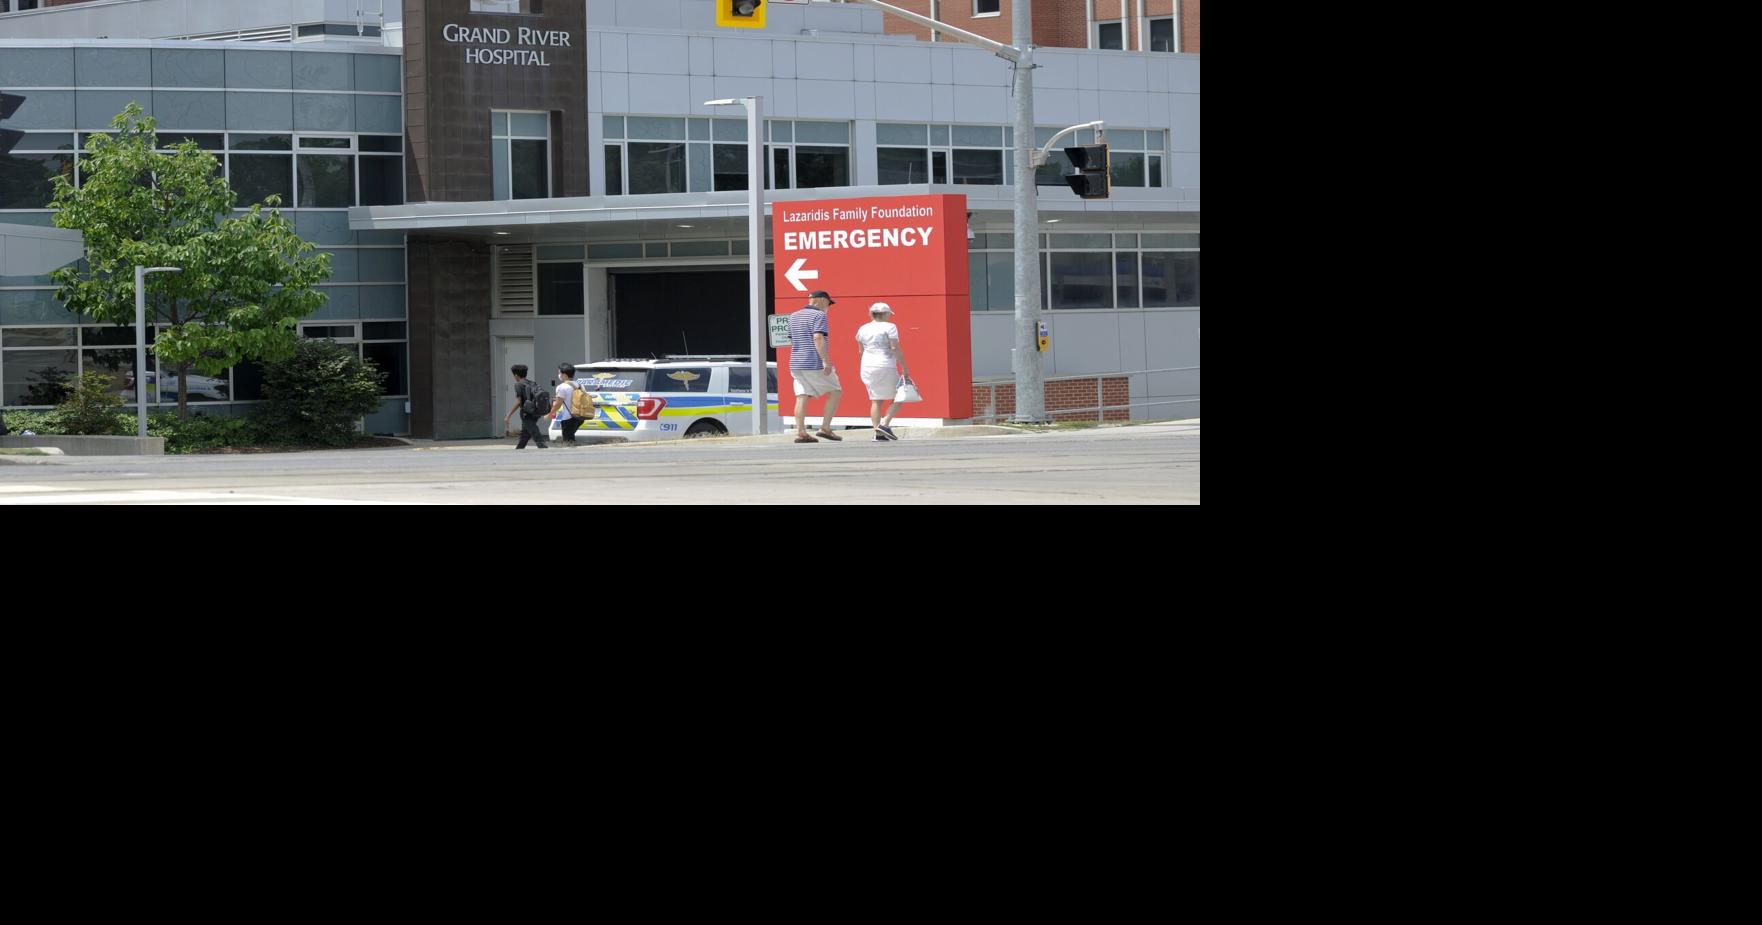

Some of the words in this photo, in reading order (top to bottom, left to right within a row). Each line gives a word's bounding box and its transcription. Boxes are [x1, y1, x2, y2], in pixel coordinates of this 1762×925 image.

[442, 23, 510, 43] GRAND
[518, 26, 571, 46] RIVER
[465, 48, 551, 66] HOSPITAL
[783, 208, 830, 223] Lazaridis
[833, 207, 868, 222] Family
[871, 205, 933, 219] Foundation
[784, 227, 933, 250] EMERGENCY
